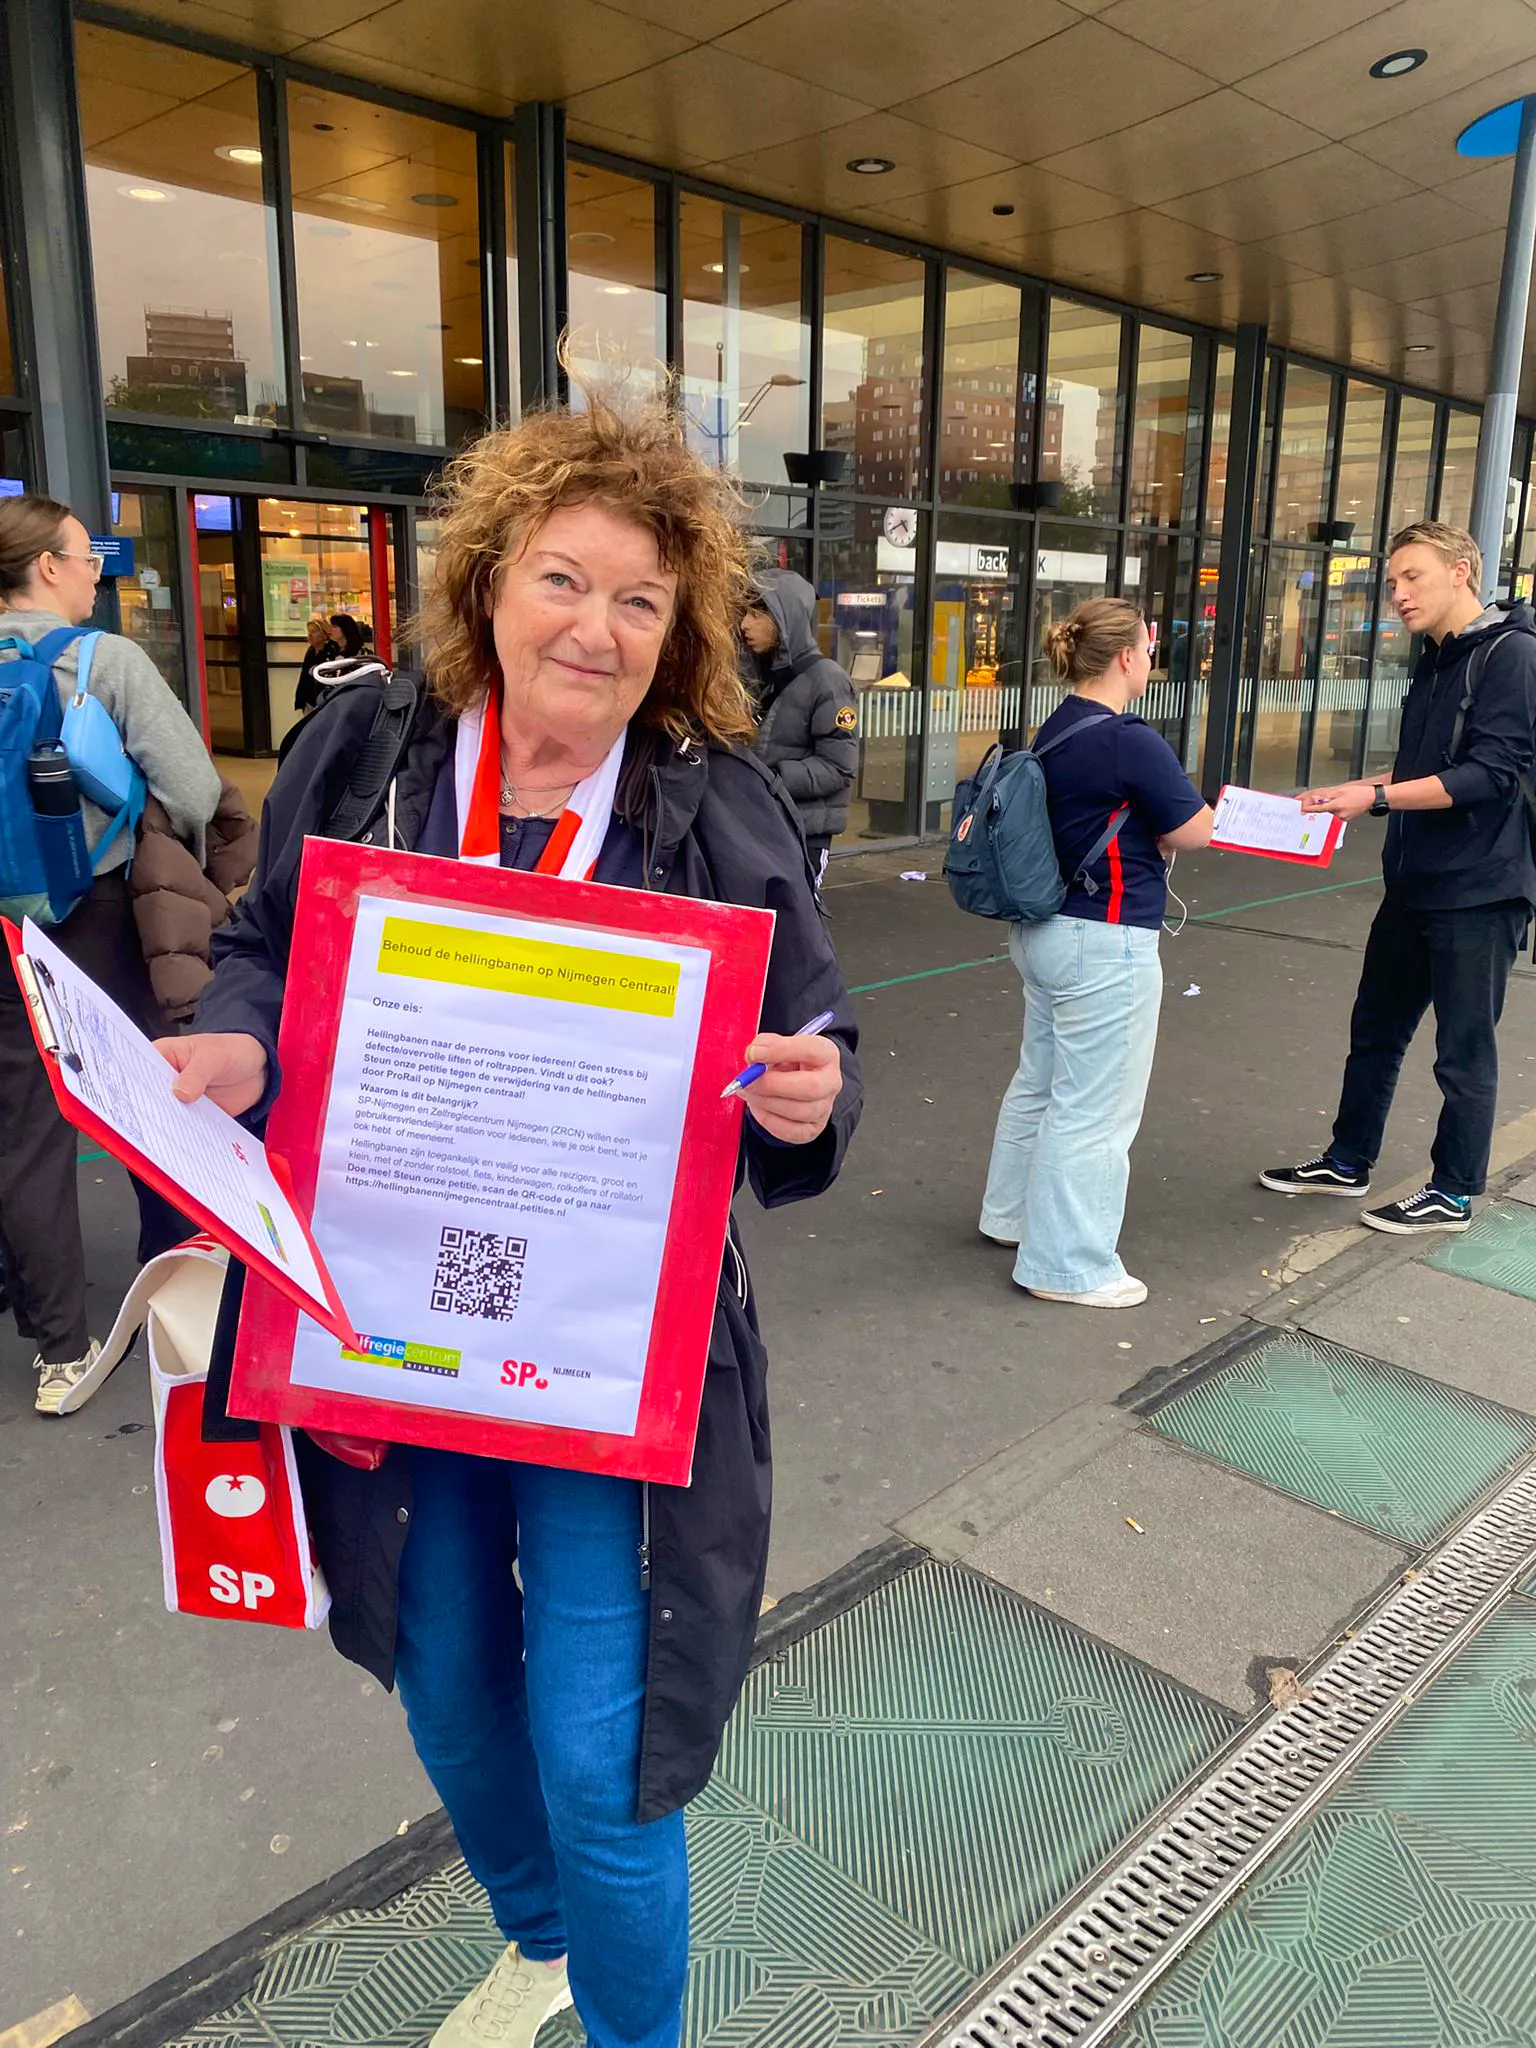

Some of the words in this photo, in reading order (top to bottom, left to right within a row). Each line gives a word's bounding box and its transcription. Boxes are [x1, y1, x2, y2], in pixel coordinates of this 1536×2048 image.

[978, 550, 1008, 572] back
[856, 595, 881, 603] Tickets
[382, 940, 433, 957] Behoud
[434, 947, 451, 960] de
[453, 950, 535, 973] hellingbanen
[537, 966, 554, 979] op
[557, 967, 616, 986] Nijmegen
[619, 977, 675, 995] Centraal!
[372, 997, 401, 1010] Onze
[402, 1002, 423, 1013] eis:
[365, 1040, 446, 1061] defecte/overvolle
[447, 1053, 472, 1065] liften
[473, 1058, 485, 1067] of
[485, 1061, 537, 1075] roltrappen.
[539, 1068, 566, 1079] Vindt
[575, 1073, 589, 1083] dit
[590, 1077, 614, 1087] ook?
[367, 1028, 430, 1045] Hellingbanen
[430, 1040, 453, 1049] naar
[454, 1041, 467, 1051] de
[468, 1046, 506, 1057] perrons
[508, 1052, 530, 1061] voor
[531, 1054, 577, 1068] iedereen!
[577, 1061, 604, 1072] Geen
[604, 1066, 634, 1077] stress
[635, 1070, 649, 1082] bij
[359, 1083, 399, 1096] Waarom
[400, 1089, 410, 1098] is
[411, 1091, 425, 1101] dit
[425, 1093, 478, 1109] belangrijk?
[361, 1066, 385, 1077] door
[386, 1070, 422, 1083] ProRail
[422, 1077, 436, 1087] op
[437, 1078, 483, 1093] Nijmegen
[483, 1087, 526, 1099] centraal!
[363, 1053, 392, 1065] Steun
[393, 1060, 417, 1069] onze
[417, 1064, 448, 1074] petitie
[449, 1067, 477, 1079] tegen
[478, 1071, 491, 1081] de
[492, 1075, 552, 1092] verwijdering
[552, 1085, 571, 1093] van
[572, 1086, 585, 1095] de
[586, 1088, 647, 1105] hellingbanen
[353, 1123, 371, 1131] ook
[371, 1124, 392, 1135] hebt
[395, 1128, 406, 1137] of
[406, 1131, 456, 1145] meeneemt.
[357, 1096, 416, 1113] SP-Nijmegen
[417, 1106, 430, 1114] en
[430, 1107, 506, 1126] Zelfregiecentrum
[506, 1119, 550, 1133] Nijmegen
[550, 1125, 586, 1141] (ZRCN)
[586, 1132, 612, 1143] willen
[613, 1137, 631, 1145] een
[455, 1125, 486, 1136] station
[486, 1131, 507, 1139] voor
[508, 1132, 549, 1147] iedereen,
[551, 1140, 568, 1149] wie
[568, 1141, 578, 1152] je
[578, 1145, 597, 1153] ook
[621, 1152, 639, 1160] wat
[638, 1152, 648, 1162] je
[349, 1150, 372, 1163] klein,
[373, 1156, 392, 1164] met
[392, 1158, 403, 1166] of
[403, 1161, 435, 1171] zonder
[436, 1165, 471, 1178] rolstoel,
[473, 1169, 495, 1182] fiets,
[496, 1173, 555, 1191] kinderwagen,
[599, 1190, 610, 1198] of
[351, 1138, 409, 1154] Hellingbanen
[409, 1147, 426, 1158] zijn
[427, 1150, 481, 1166] toegankelijk
[495, 1161, 519, 1173] veilig
[520, 1166, 540, 1174] voor
[541, 1168, 558, 1177] alle
[559, 1171, 600, 1185] reizigers,
[600, 1178, 625, 1188] groot
[347, 1163, 367, 1173] Doe
[368, 1168, 392, 1177] mee!
[393, 1170, 422, 1182] Steun
[423, 1176, 447, 1186] onze
[447, 1180, 480, 1192] petitie,
[482, 1185, 506, 1195] scan
[506, 1187, 519, 1197] de
[520, 1190, 563, 1204] QR-code
[564, 1197, 575, 1205] of
[575, 1200, 588, 1209] ga
[590, 1202, 612, 1211] naar
[359, 1336, 460, 1364] lfregiecentrum
[406, 1362, 457, 1376] NIJMEGEN
[553, 1366, 592, 1379] NIJMEGEN
[209, 1564, 275, 1610] SP
